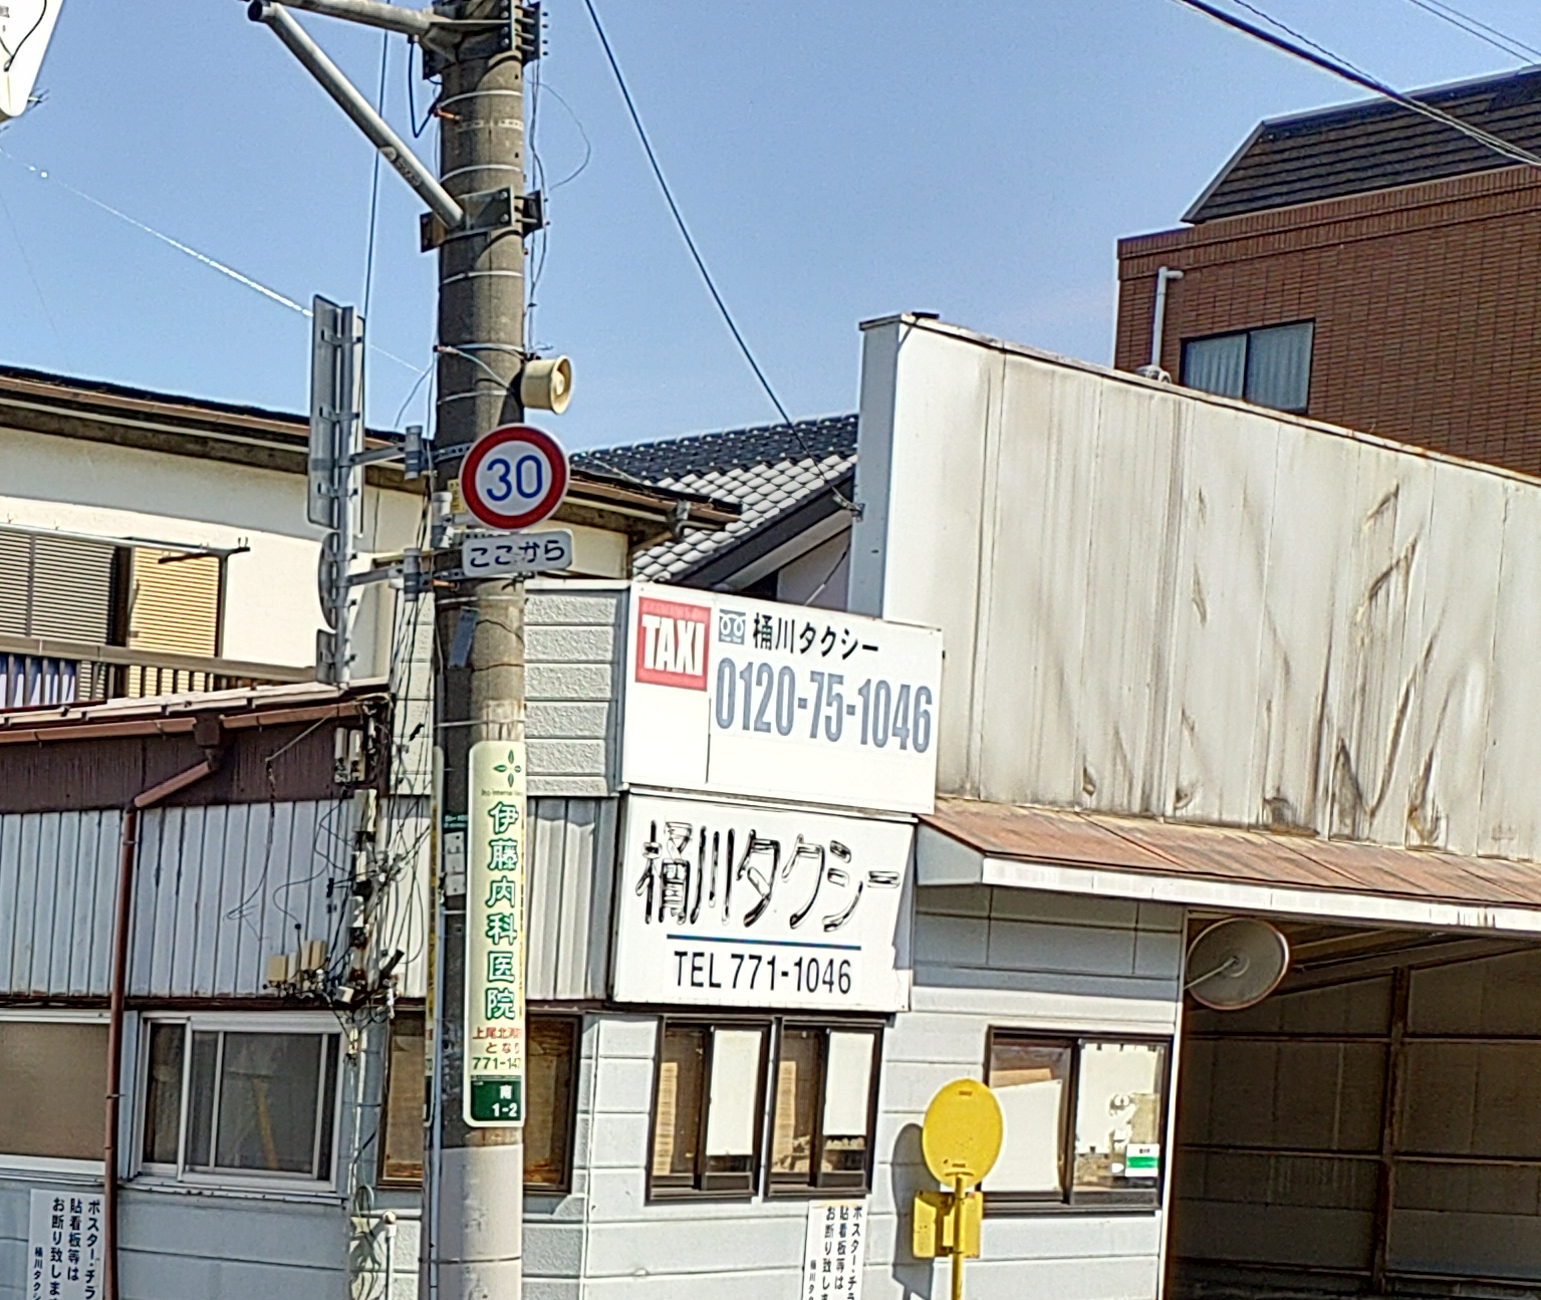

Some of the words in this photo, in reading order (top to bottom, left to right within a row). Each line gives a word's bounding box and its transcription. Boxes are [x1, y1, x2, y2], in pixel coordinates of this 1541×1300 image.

[486, 454, 543, 502] 30
[470, 539, 565, 568] ここから
[641, 613, 706, 677] TAXI
[753, 612, 879, 661] 桶川タクシー
[715, 657, 933, 754] 0120-75-1046
[635, 819, 901, 933] 桶川タクシー
[485, 800, 520, 1022] 伊藤内科医院
[674, 951, 721, 989] TEL
[731, 953, 851, 994] 771-1046
[492, 1103, 517, 1117] 1-2
